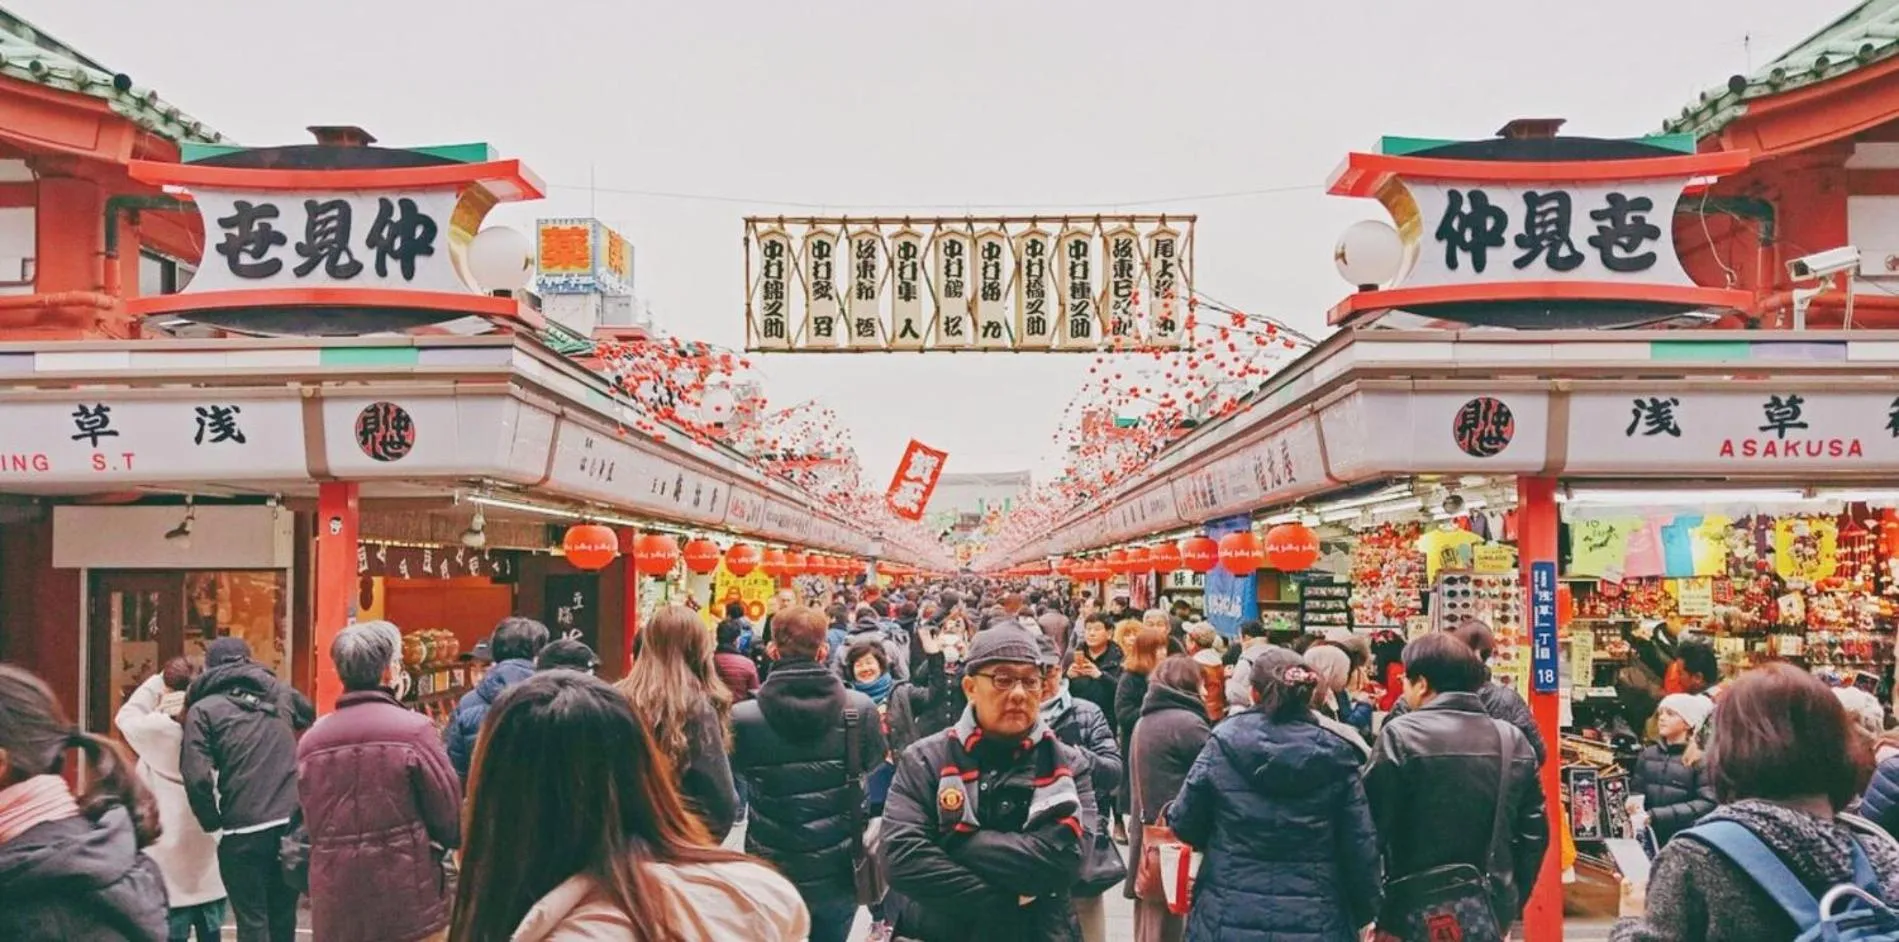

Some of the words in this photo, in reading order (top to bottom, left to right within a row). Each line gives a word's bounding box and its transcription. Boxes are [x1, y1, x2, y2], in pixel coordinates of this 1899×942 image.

[1434, 188, 1661, 273] 仲見世
[1720, 439, 1863, 458] ASAKUSA
[1538, 668, 1555, 684] 18
